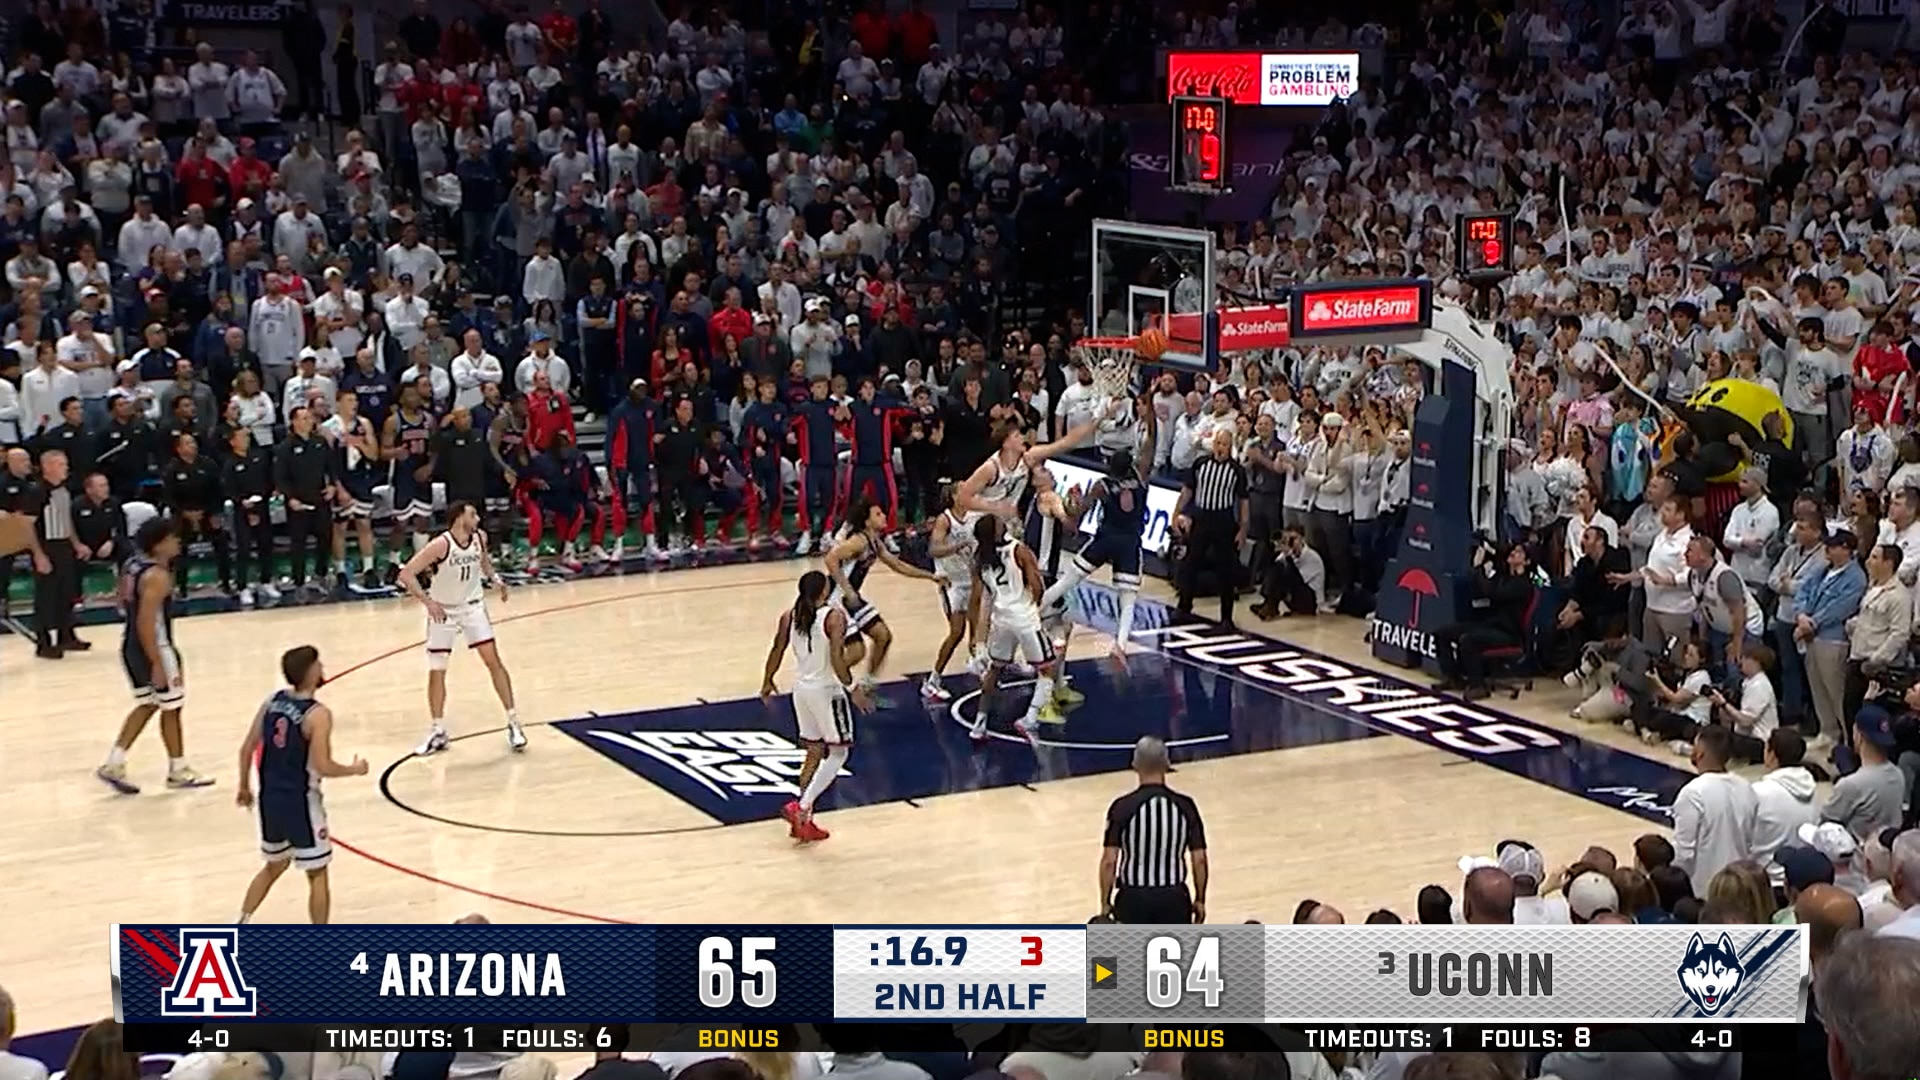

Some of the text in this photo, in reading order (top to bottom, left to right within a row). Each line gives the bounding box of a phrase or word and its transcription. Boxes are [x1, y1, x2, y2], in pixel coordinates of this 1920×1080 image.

[181, 4, 281, 20] TRAVELERS
[1269, 71, 1350, 83] PROBLEM
[1269, 84, 1350, 96] GAMBLING
[460, 564, 471, 582] 11
[996, 561, 1009, 586] 2
[1372, 617, 1438, 659] TRAVELE
[1130, 623, 1561, 755] HUSKIES
[272, 716, 289, 749] 3
[630, 731, 802, 797] EAST
